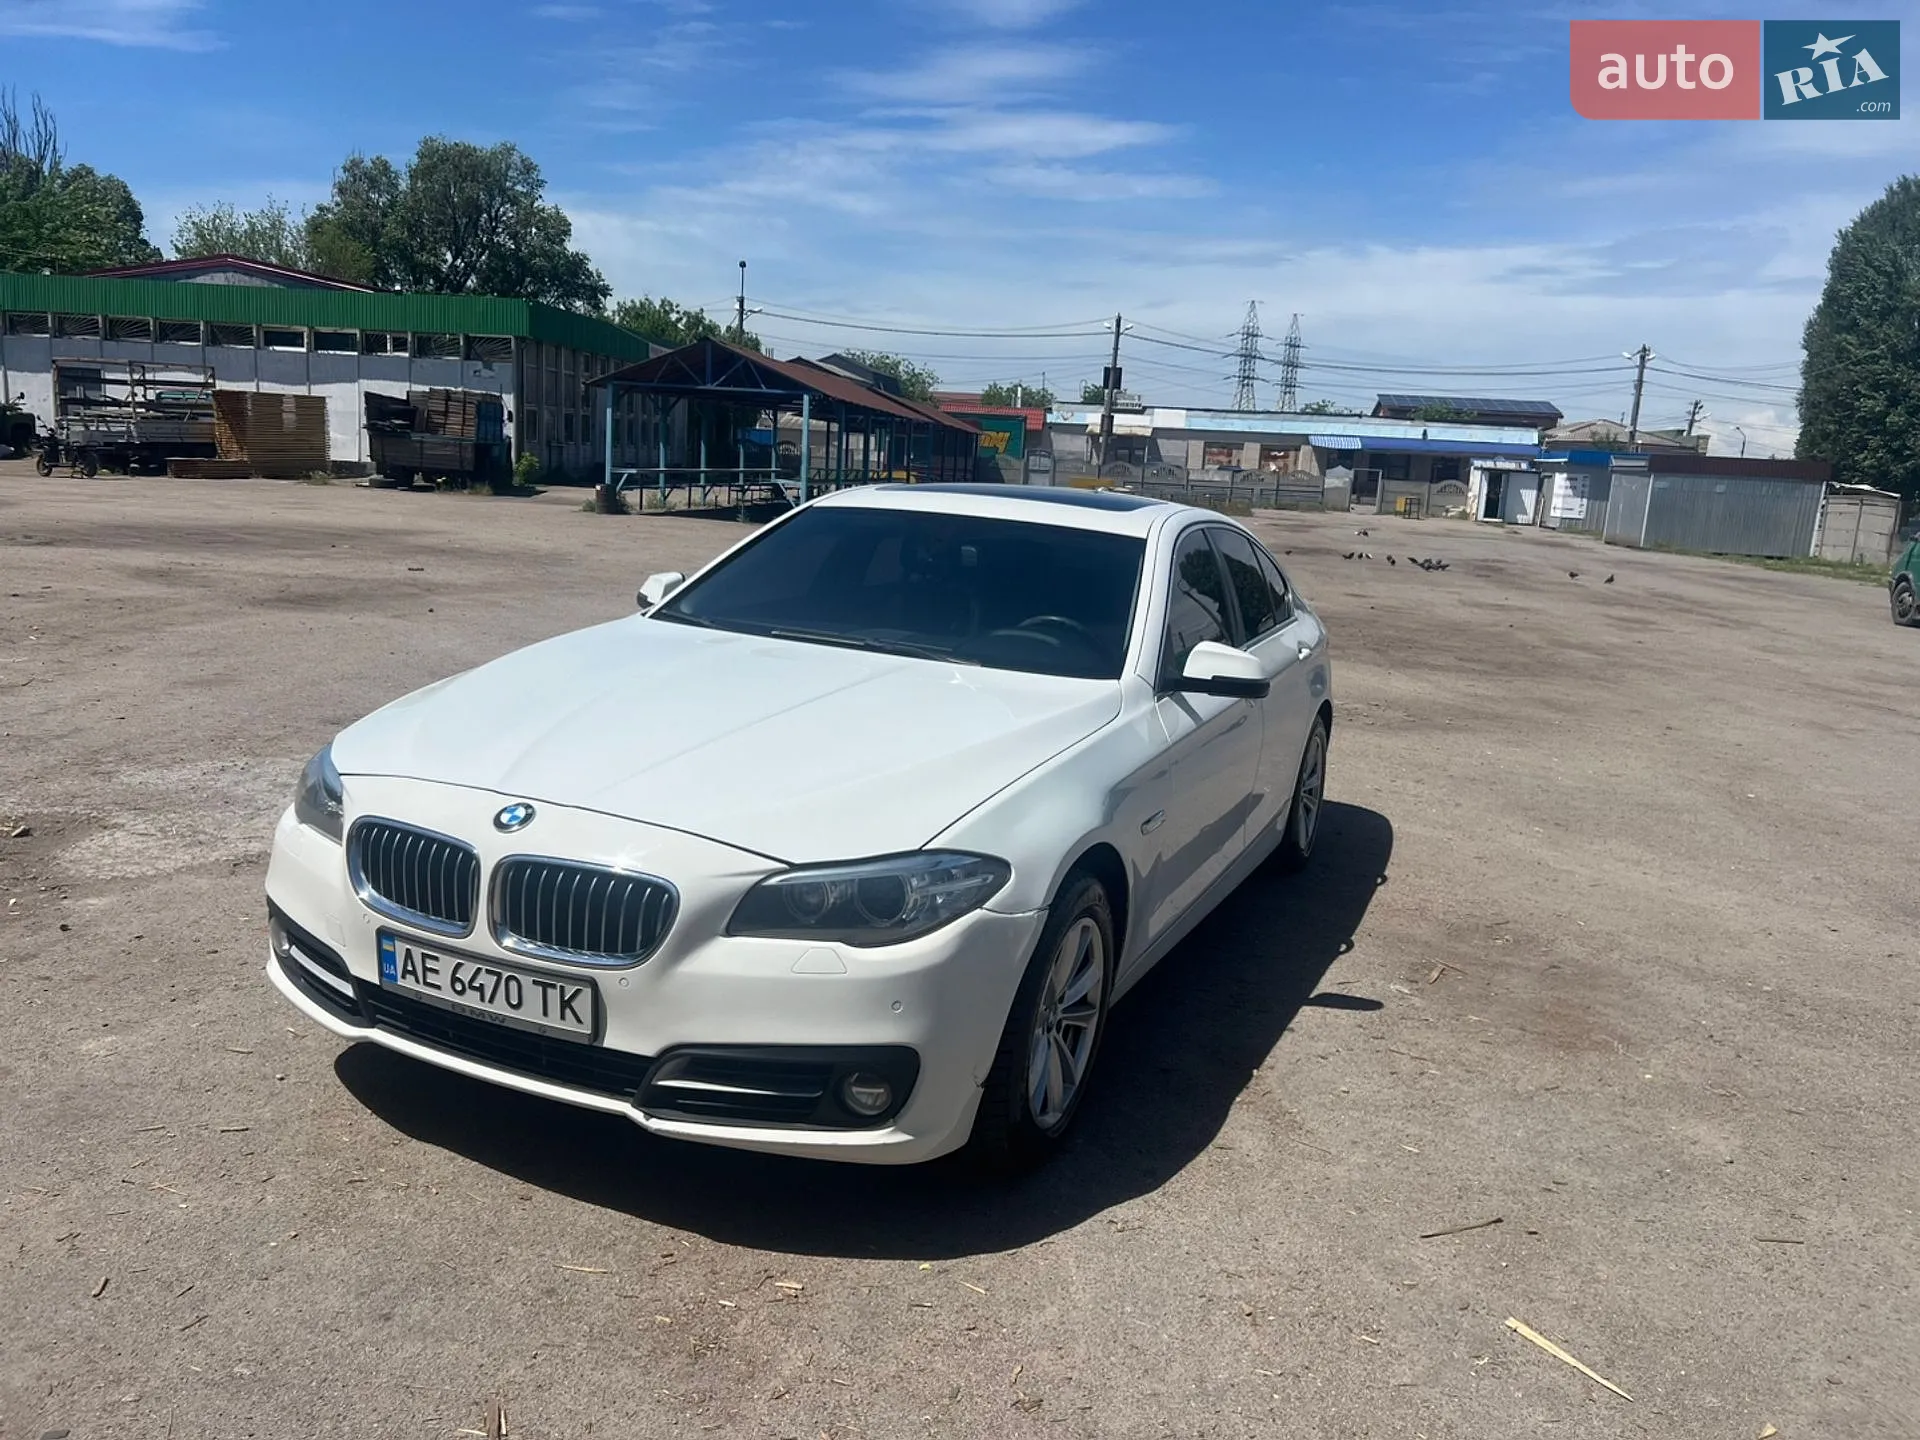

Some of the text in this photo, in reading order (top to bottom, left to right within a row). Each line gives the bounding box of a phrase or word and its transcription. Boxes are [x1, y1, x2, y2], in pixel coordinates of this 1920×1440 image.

[383, 962, 397, 977] UA
[401, 947, 584, 1025] AE 6470 TK
